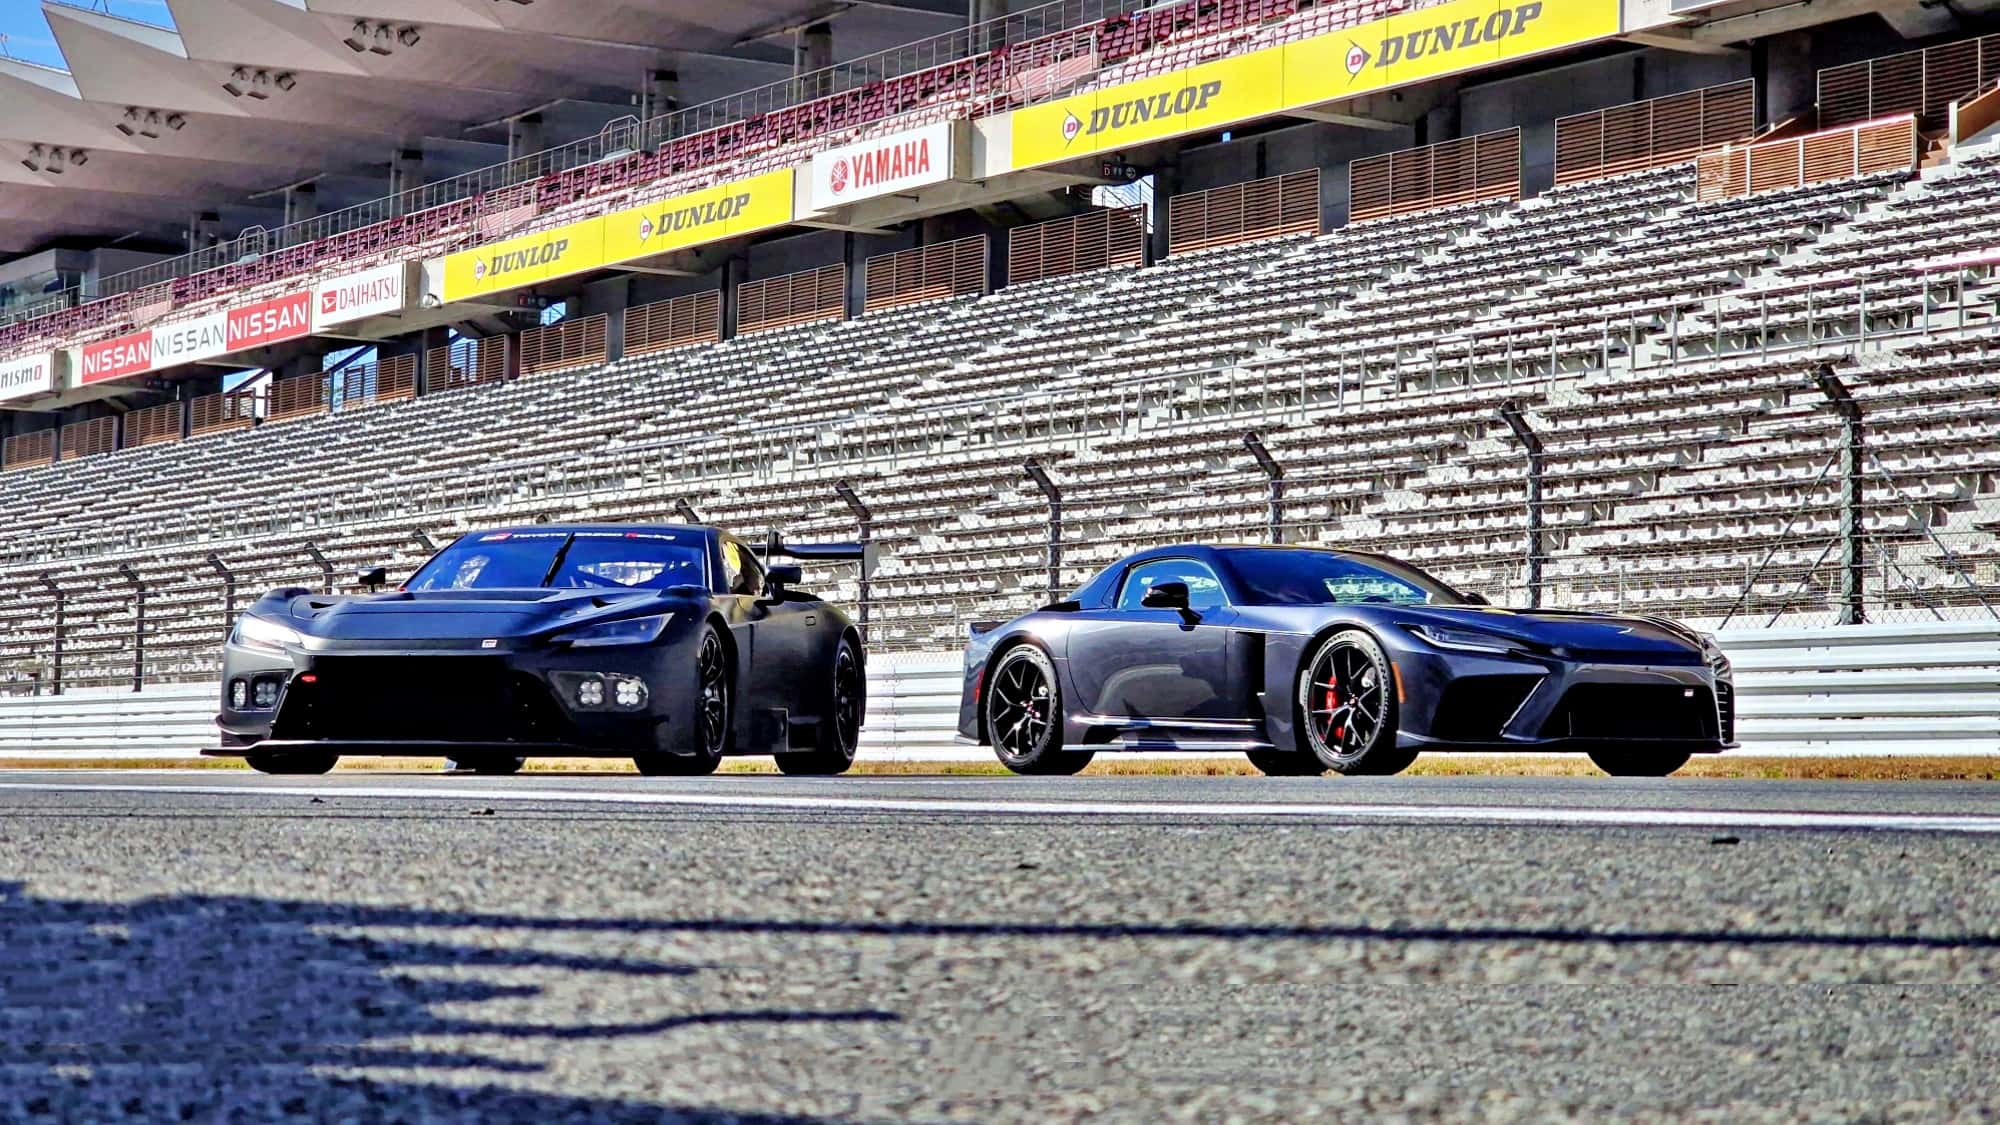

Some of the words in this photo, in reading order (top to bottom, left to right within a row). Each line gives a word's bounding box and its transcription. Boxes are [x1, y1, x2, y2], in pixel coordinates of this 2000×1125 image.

[1374, 2, 1543, 69] DUNLOP
[1086, 80, 1222, 135] DUNLOP
[852, 138, 930, 189] YAMAHA
[656, 193, 750, 236] DUNLOP
[488, 239, 568, 276] DUNLOP
[340, 275, 399, 310] DAIHATSU
[154, 321, 225, 359] NISSAN
[229, 302, 306, 342] NISSAN
[84, 339, 150, 376] NISSAN
